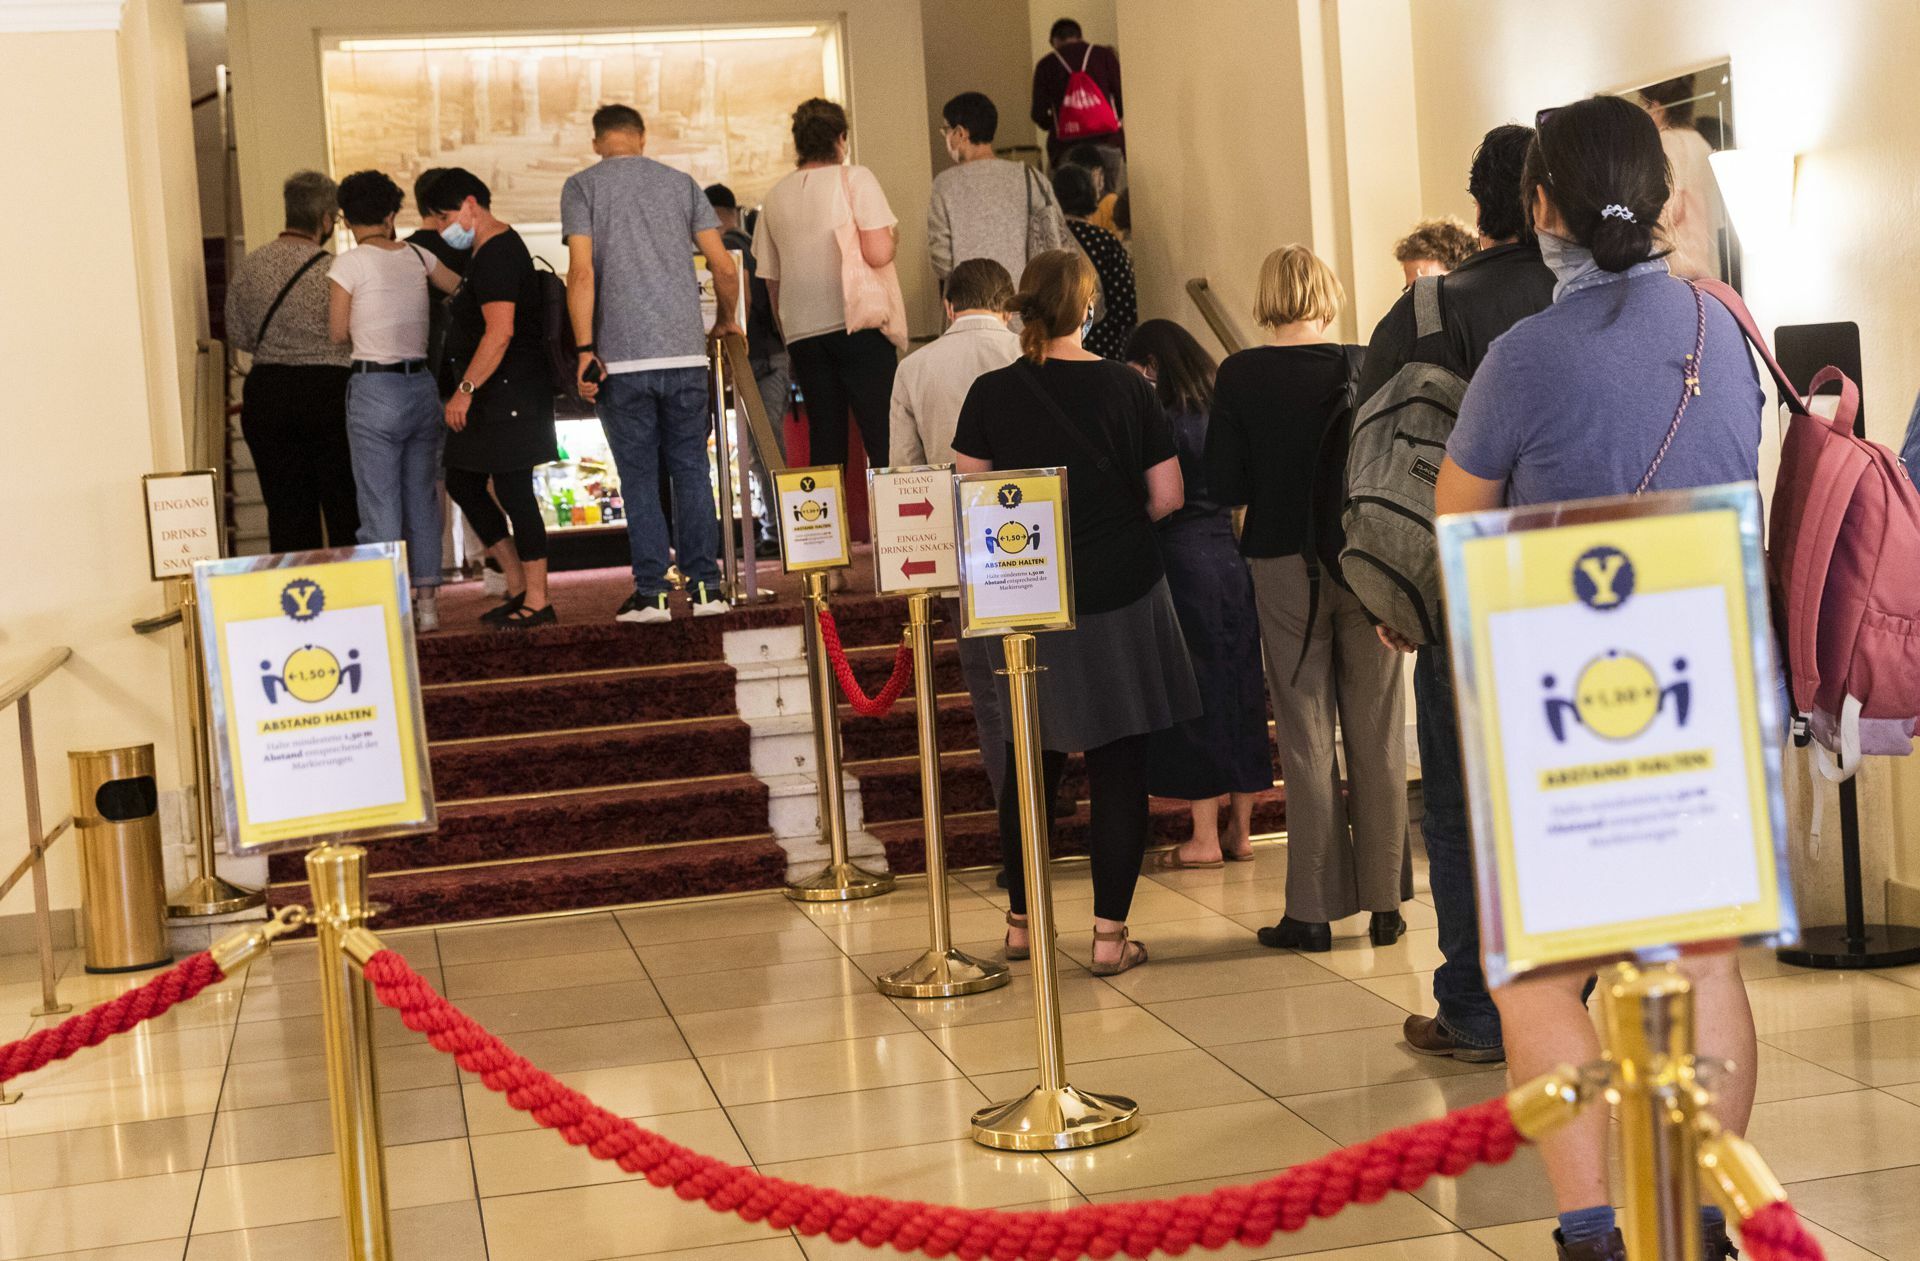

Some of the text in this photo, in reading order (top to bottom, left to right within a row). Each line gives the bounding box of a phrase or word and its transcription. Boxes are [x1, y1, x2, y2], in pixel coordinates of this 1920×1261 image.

[893, 476, 933, 485] EINGANG
[898, 486, 929, 495] TICKET
[153, 497, 209, 512] EINGANG
[161, 528, 207, 541] DRINKS
[897, 533, 937, 543] EINGANG
[181, 543, 191, 553] &
[881, 545, 913, 554] DRINKS
[920, 542, 955, 551] SNACKS
[985, 558, 1044, 569] ABSTAND HALTEN
[1580, 553, 1625, 603] Y
[287, 586, 316, 617] Y
[300, 670, 325, 682] 1,50
[263, 708, 371, 732] ABSTAND HALTEN
[264, 750, 303, 763] Abstand
